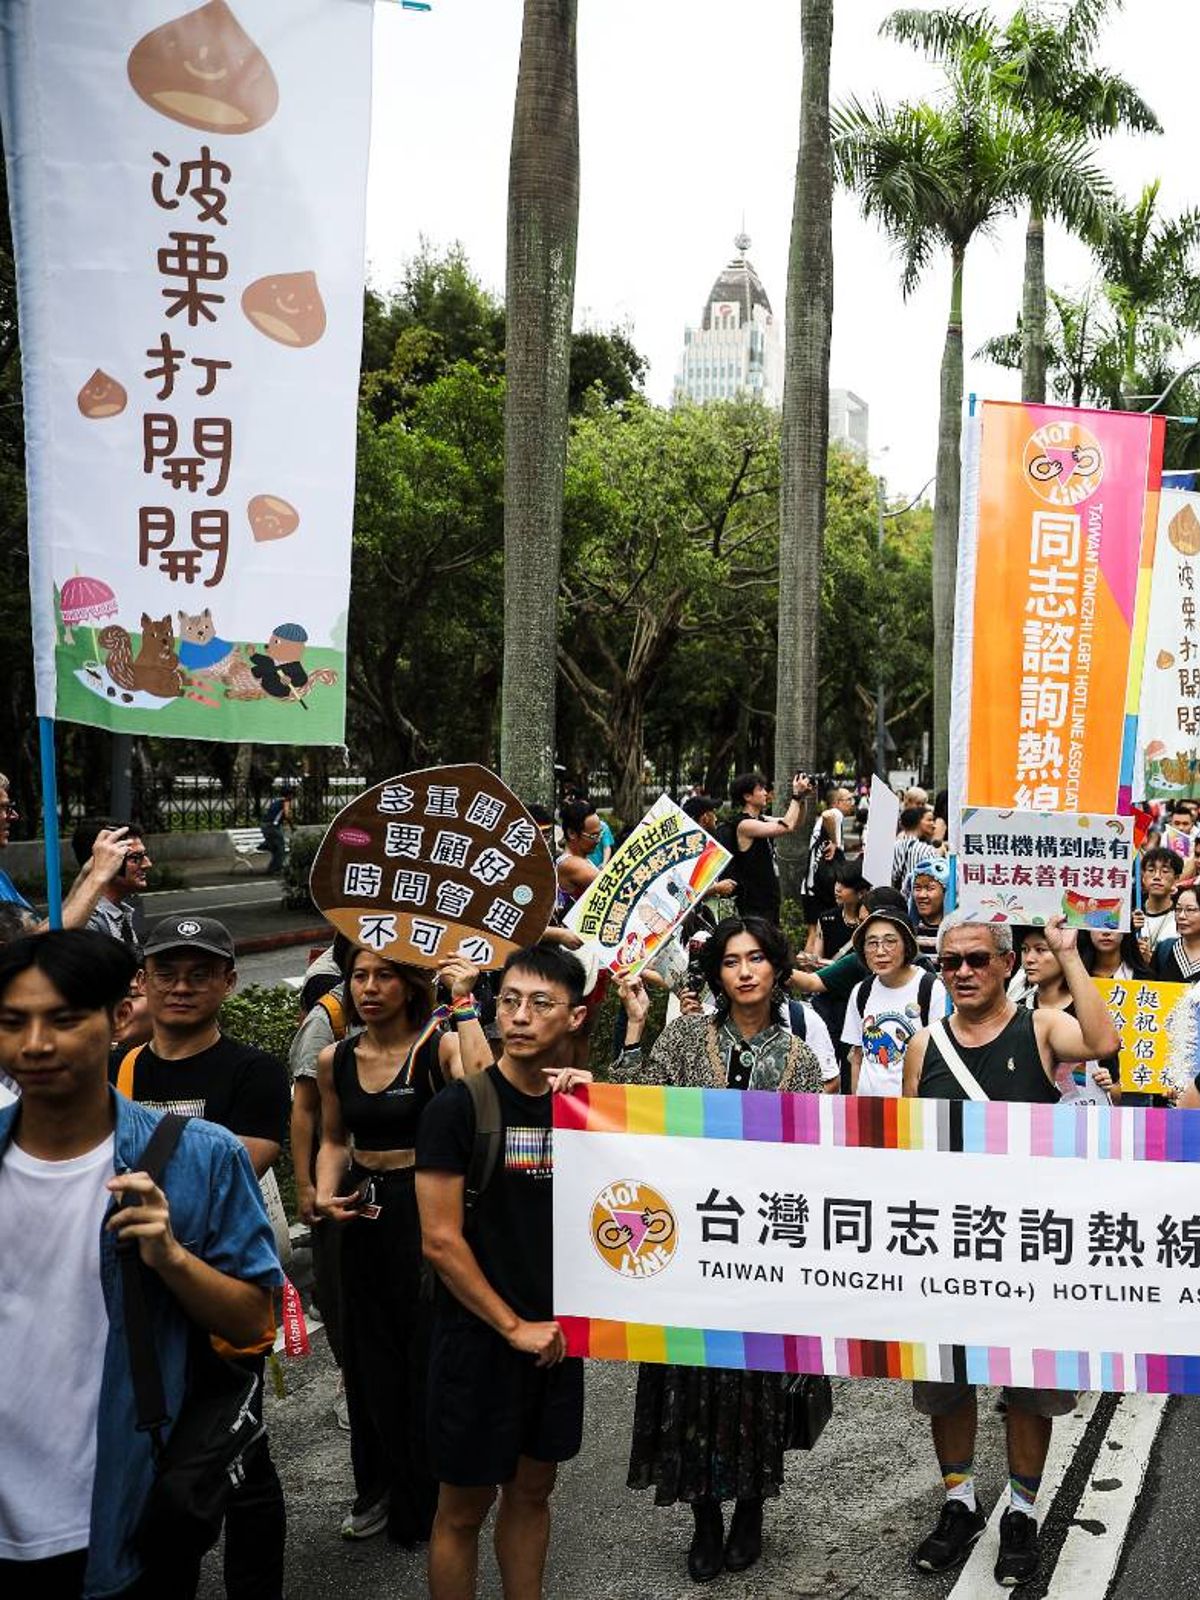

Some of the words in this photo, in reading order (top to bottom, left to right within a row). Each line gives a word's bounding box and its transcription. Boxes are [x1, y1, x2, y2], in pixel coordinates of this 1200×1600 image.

[138, 146, 232, 588] 波栗打開開
[1033, 422, 1075, 450] HOT
[1085, 503, 1104, 563] TAIWAN
[1080, 566, 1098, 631] TONGZHI
[1076, 634, 1093, 672] LGBT
[1070, 674, 1089, 739] HOTLINE
[378, 784, 536, 855] 多重關係
[963, 833, 1130, 860] 長照機構到處有
[386, 822, 514, 885] 要顧好
[580, 814, 681, 934] 同志兒女有出櫃
[962, 863, 1129, 889] 同志友善有沒有
[344, 863, 523, 938] 時間管理
[360, 914, 492, 964] 不可少
[598, 1182, 642, 1211] HOT
[698, 1260, 784, 1284] TAIWAN
[800, 1268, 903, 1293] TONGZHI
[920, 1276, 1035, 1303] (LGBTQ+)
[1053, 1283, 1162, 1303] HOTLINE
